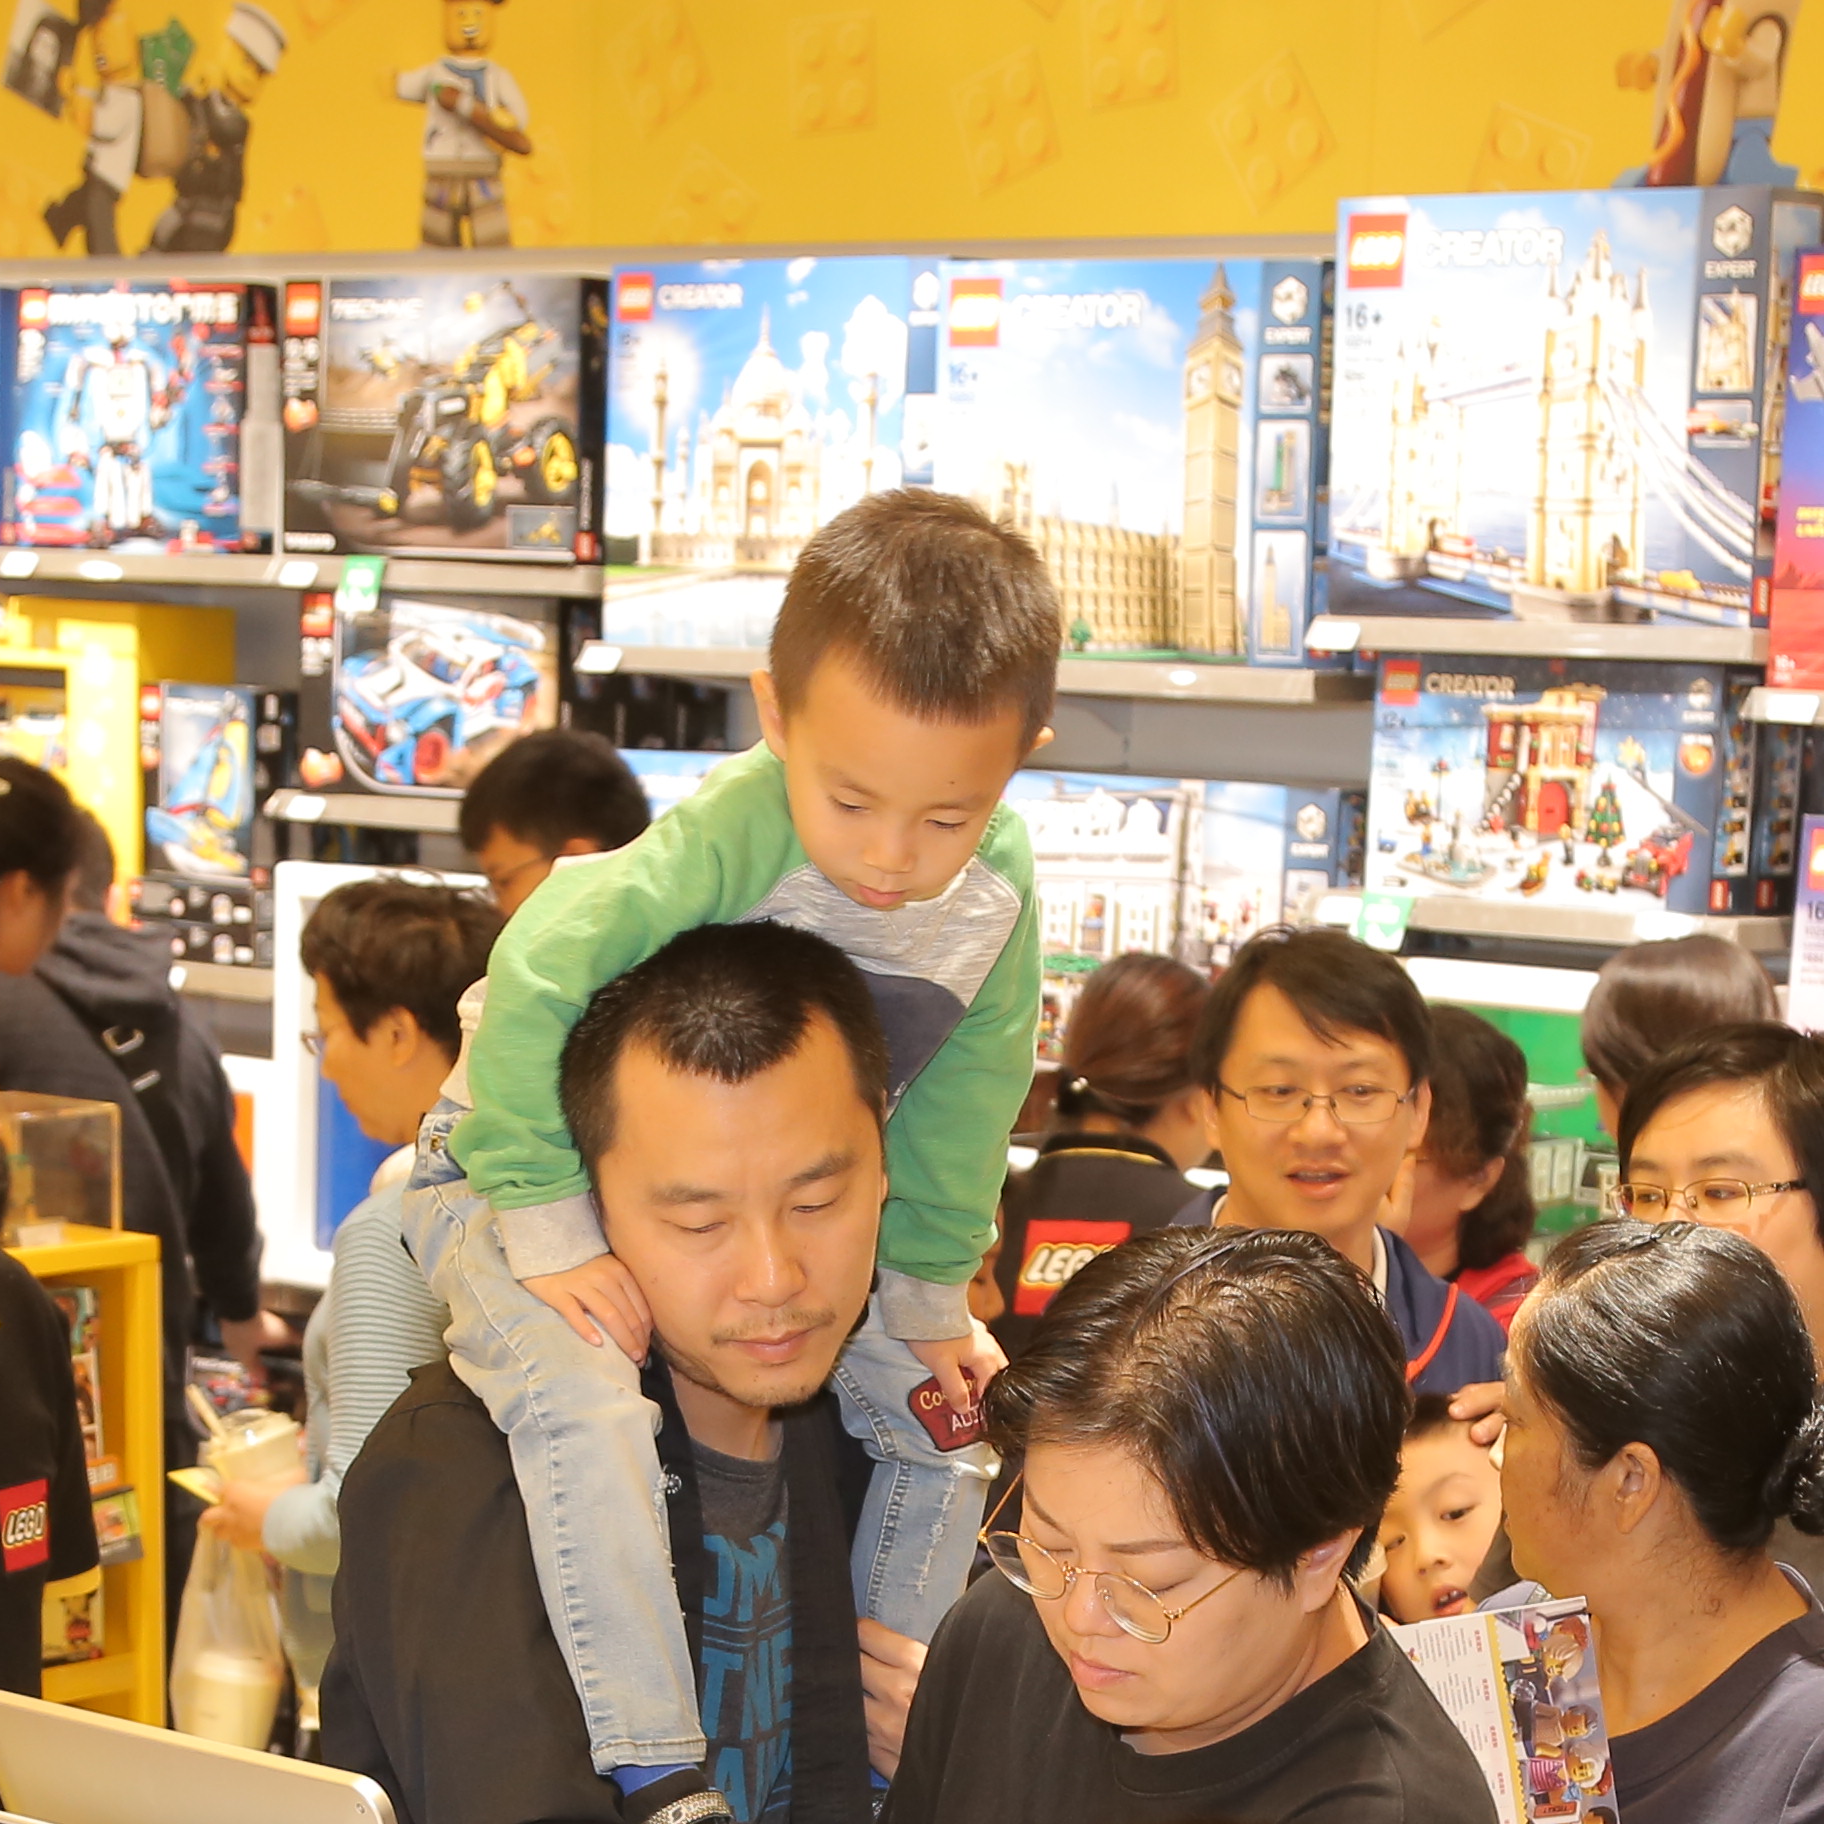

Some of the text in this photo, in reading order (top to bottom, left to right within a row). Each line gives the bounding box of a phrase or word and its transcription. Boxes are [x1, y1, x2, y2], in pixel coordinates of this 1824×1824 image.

[1419, 228, 1564, 267] CREATOR
[1012, 294, 1142, 329] CREATOR
[1425, 673, 1516, 700] CREATOR
[1025, 1246, 1106, 1285] LEG
[3, 1502, 48, 1548] LEGO
